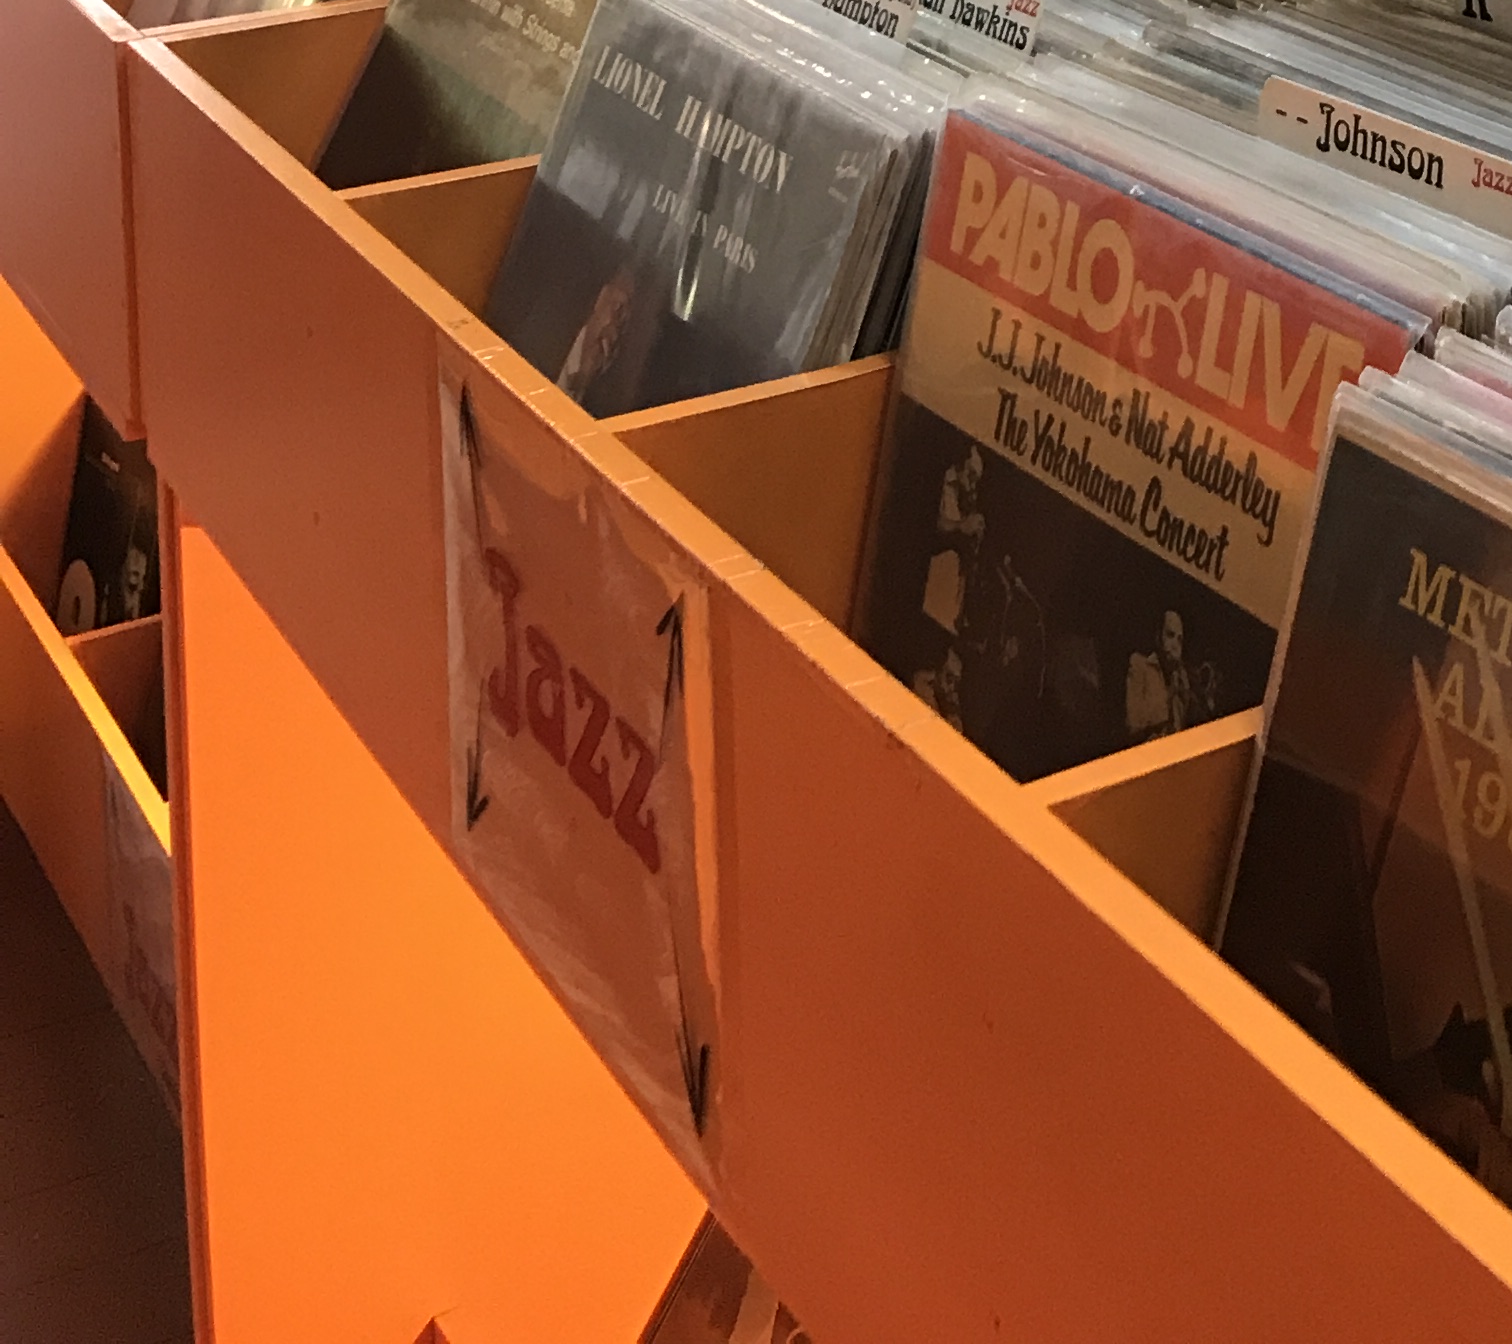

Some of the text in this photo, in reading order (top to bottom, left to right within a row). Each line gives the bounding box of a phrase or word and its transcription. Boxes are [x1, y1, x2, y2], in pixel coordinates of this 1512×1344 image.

[593, 45, 667, 122] LIONEL
[1314, 101, 1446, 191] Johnson
[948, 149, 1135, 334] PABLO
[993, 386, 1230, 582] The Yokohama Concert
[1107, 387, 1281, 548] & Nat Adderley
[483, 544, 665, 876] Jazz
